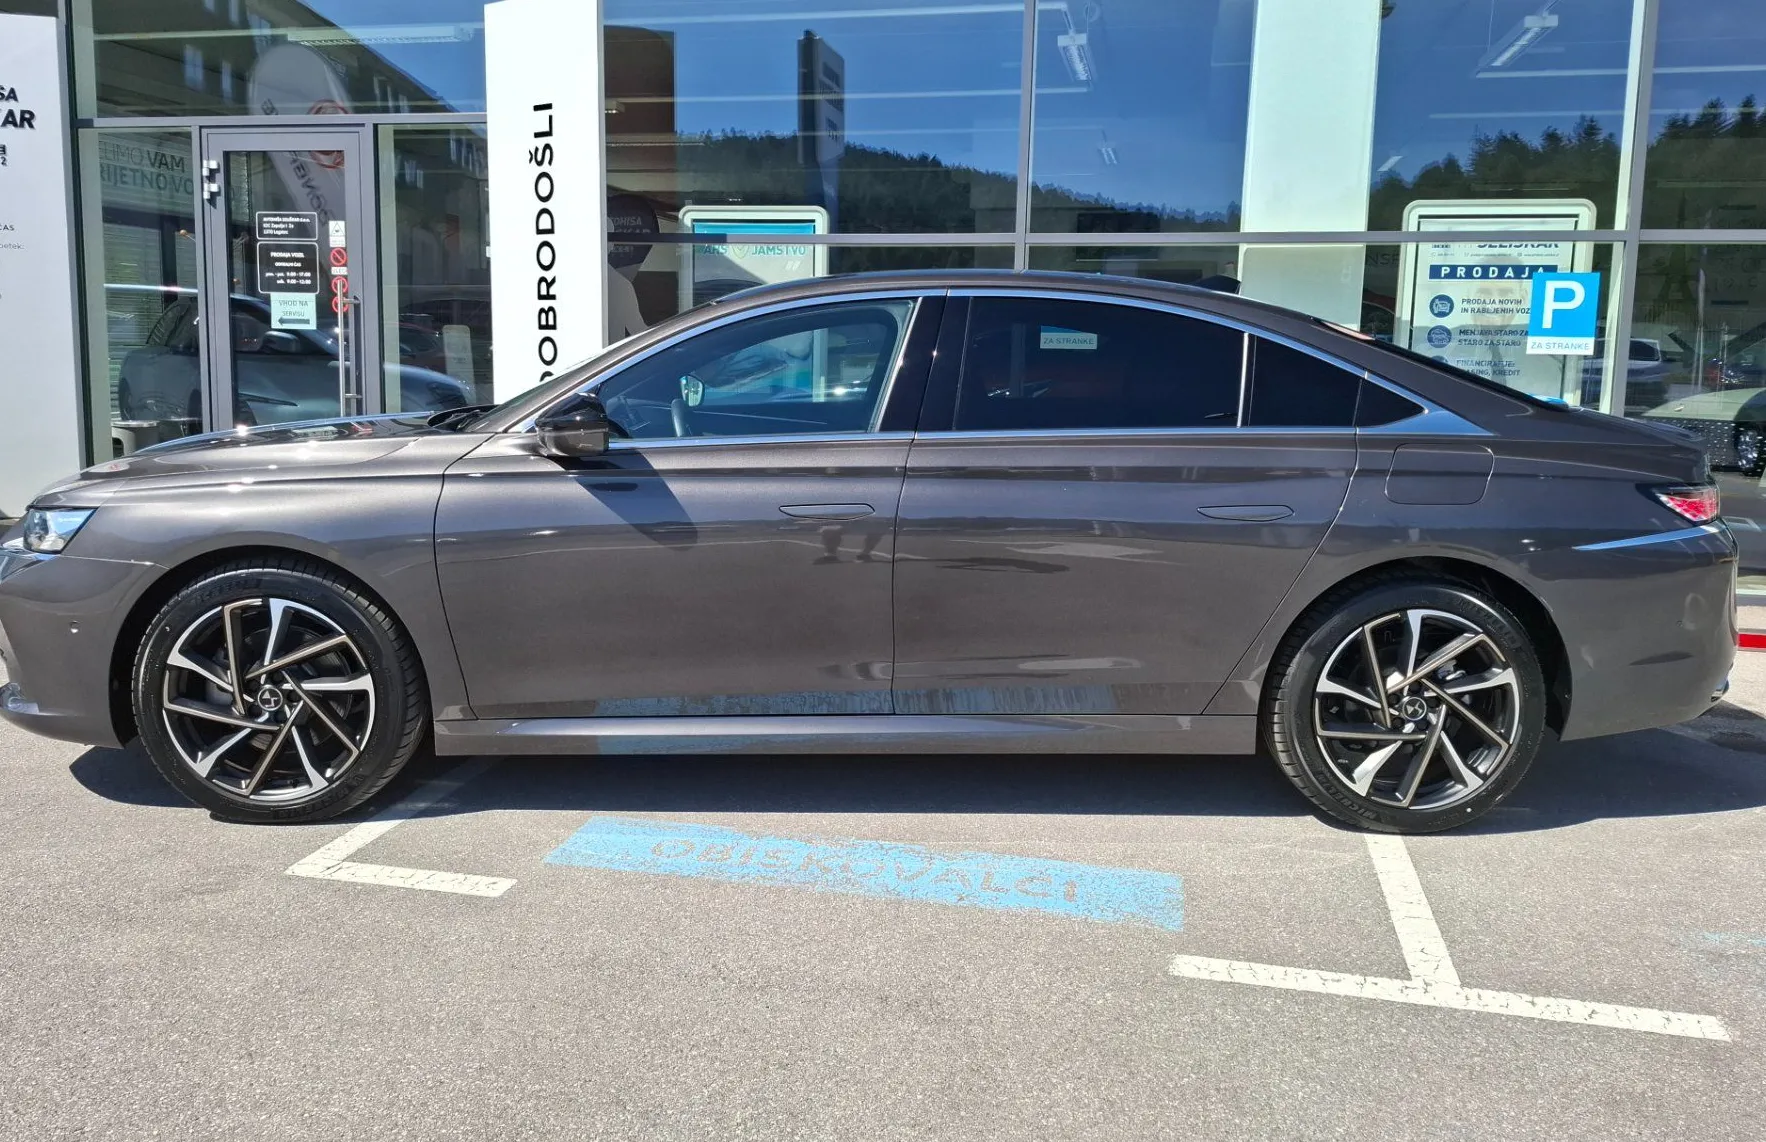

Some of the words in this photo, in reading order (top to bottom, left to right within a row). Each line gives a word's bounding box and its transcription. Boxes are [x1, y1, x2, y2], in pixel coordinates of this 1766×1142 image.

[0, 108, 36, 130] AR
[147, 151, 185, 173] VAM
[100, 164, 168, 191] RIJETNO
[1542, 280, 1586, 328] P
[1043, 337, 1055, 345] ZA
[1056, 337, 1094, 345] STRANKE
[1531, 341, 1543, 349] ZA
[1545, 342, 1590, 350] STRANKE
[651, 839, 1077, 902] OBISKOVALCI
